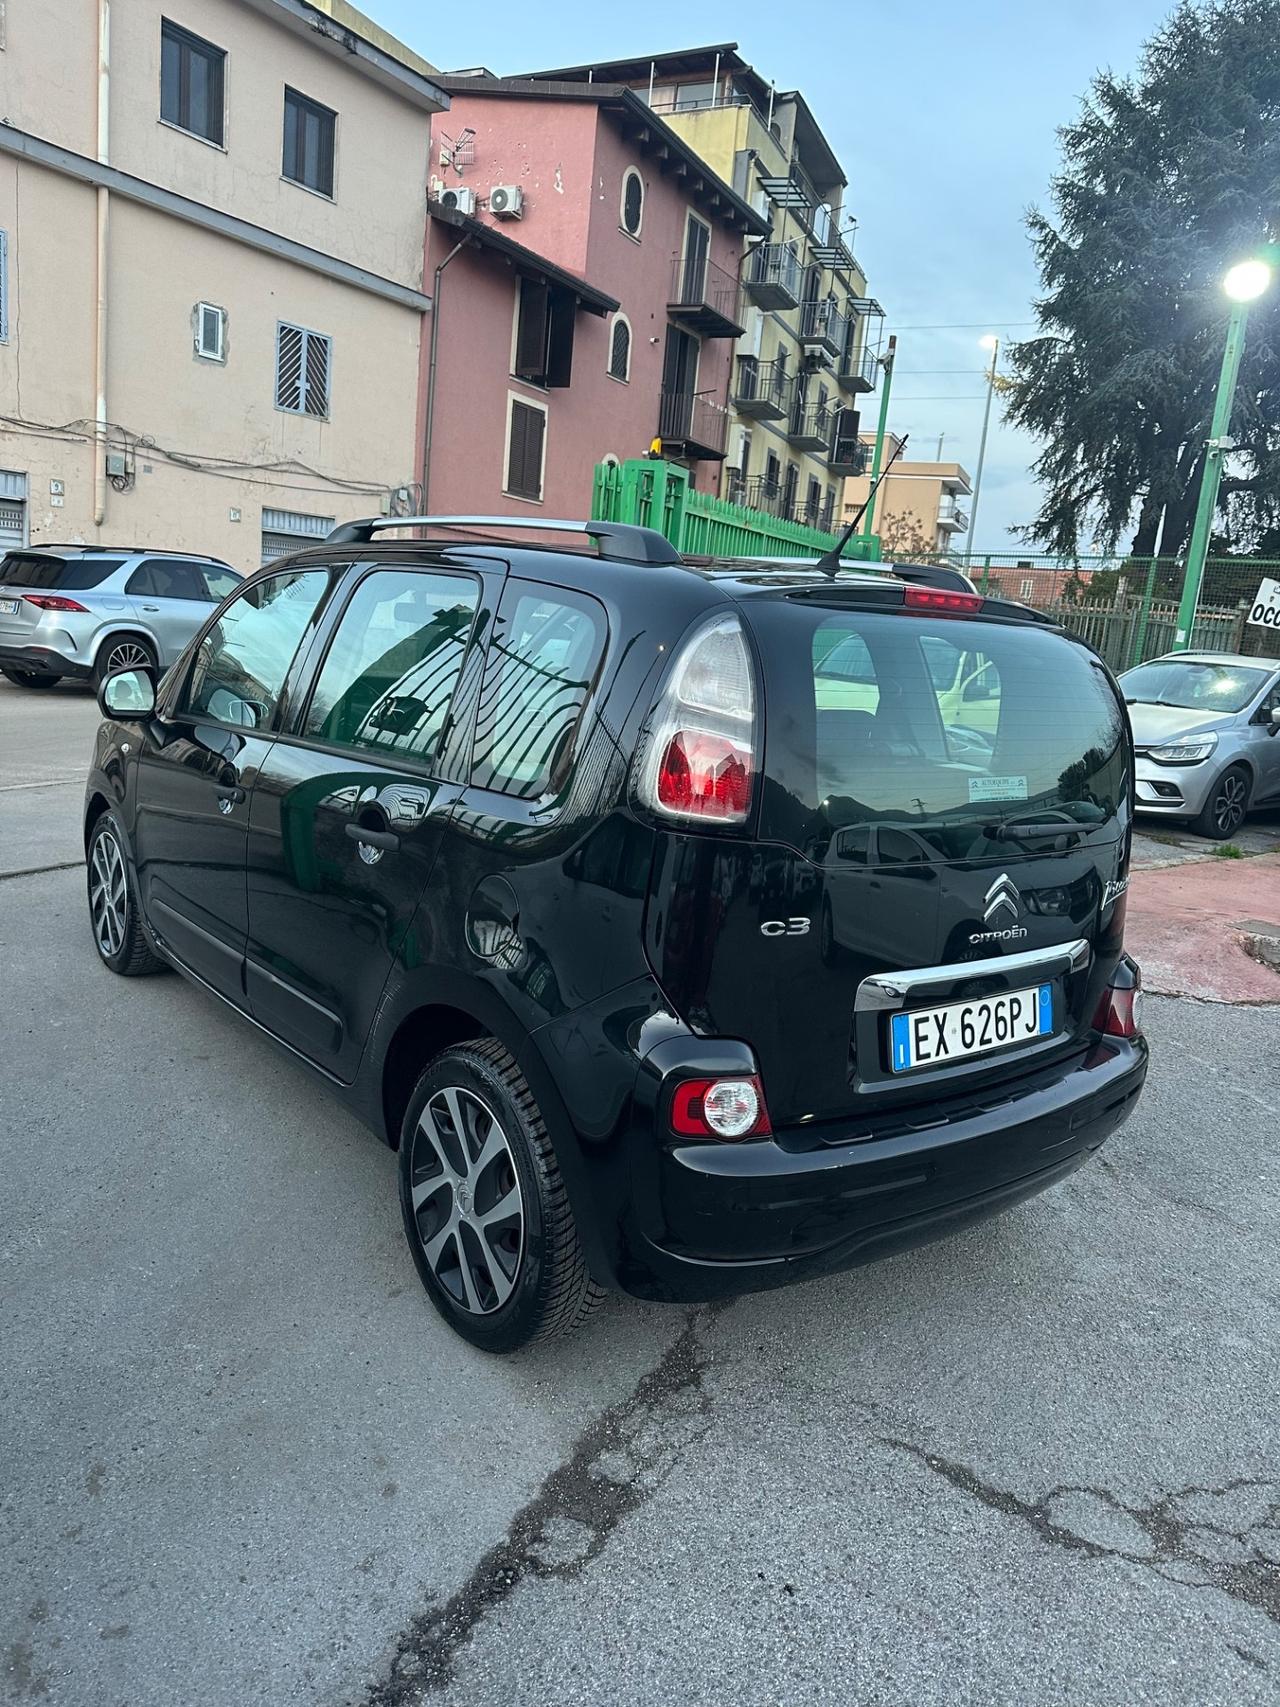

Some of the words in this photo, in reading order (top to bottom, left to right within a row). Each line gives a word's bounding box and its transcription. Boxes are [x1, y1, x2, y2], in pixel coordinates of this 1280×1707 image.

[761, 917, 811, 936] C3
[914, 1012, 949, 1061] EX
[960, 993, 1037, 1049] 626PJ
